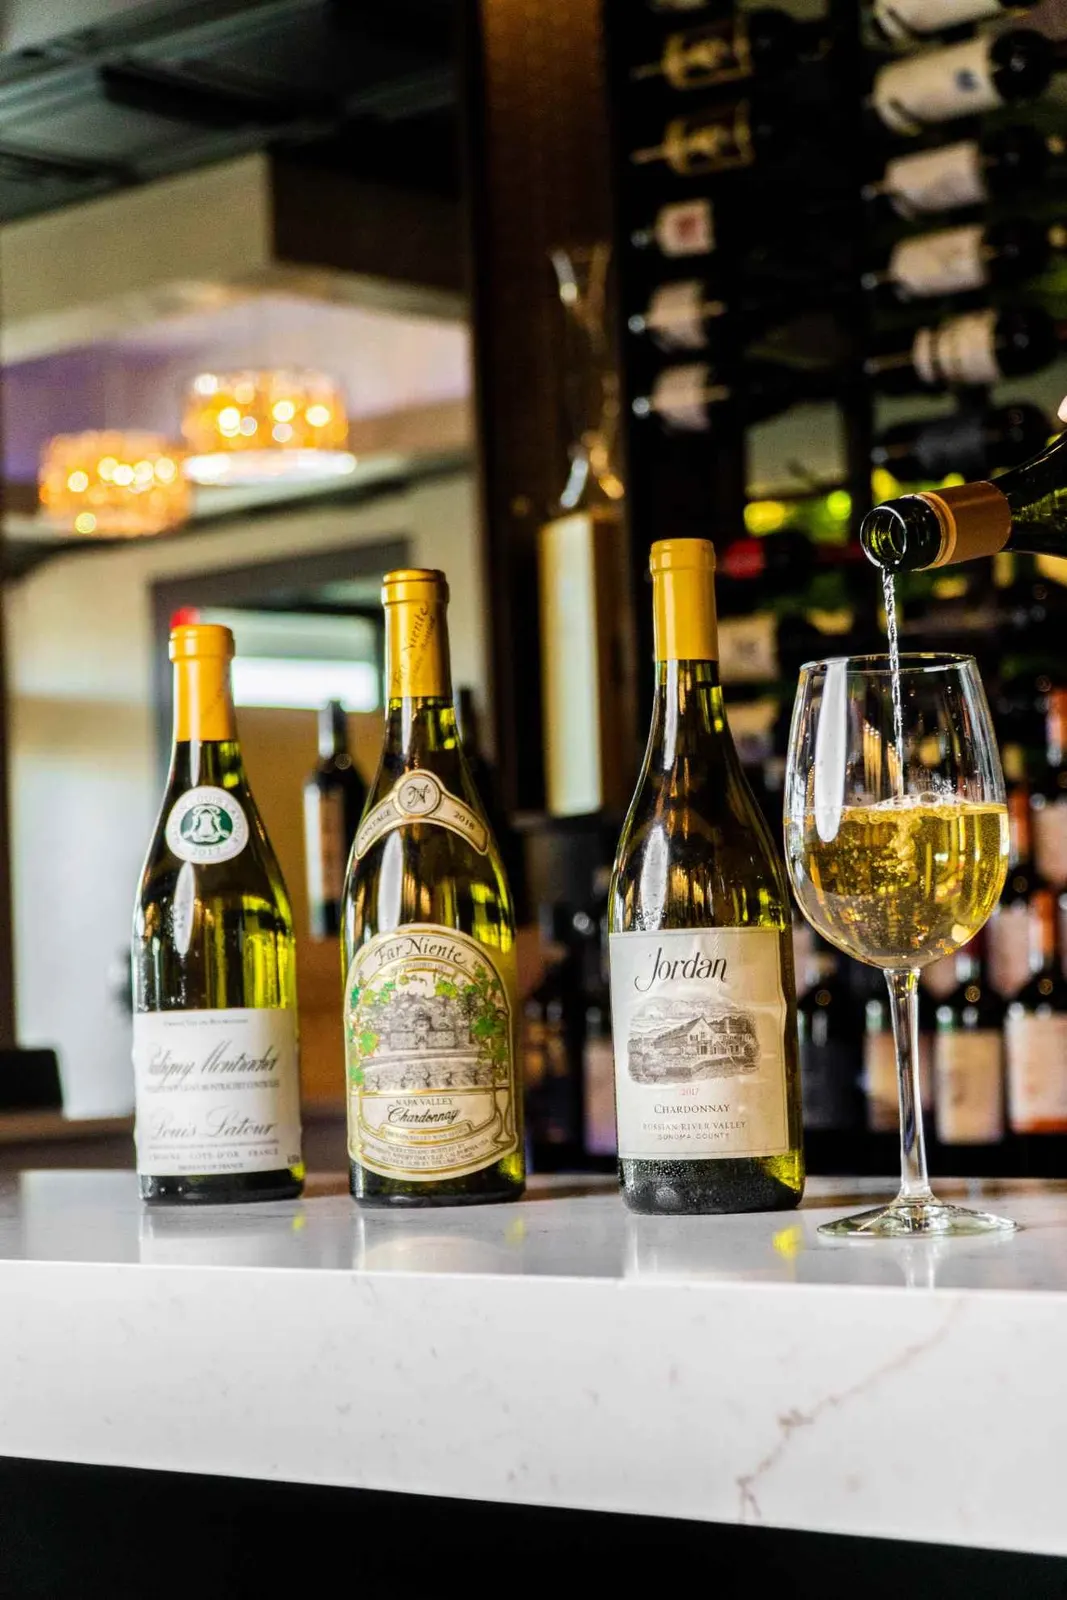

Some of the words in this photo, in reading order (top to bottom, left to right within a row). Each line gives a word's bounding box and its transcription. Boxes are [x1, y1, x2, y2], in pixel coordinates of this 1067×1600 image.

[453, 811, 475, 830] 2018
[374, 942, 403, 966] Far
[405, 936, 467, 965] Niente
[634, 947, 728, 993] Jordan
[681, 1087, 699, 1096] 2017
[396, 1097, 418, 1106] NAPA
[419, 1096, 454, 1106] VALLEY
[653, 1103, 731, 1114] CHARDONNAY
[386, 1104, 461, 1125] Chardonnay
[680, 1122, 710, 1131] RIVER
[712, 1120, 747, 1130] VALLEY
[695, 1132, 730, 1140] COUNTY
